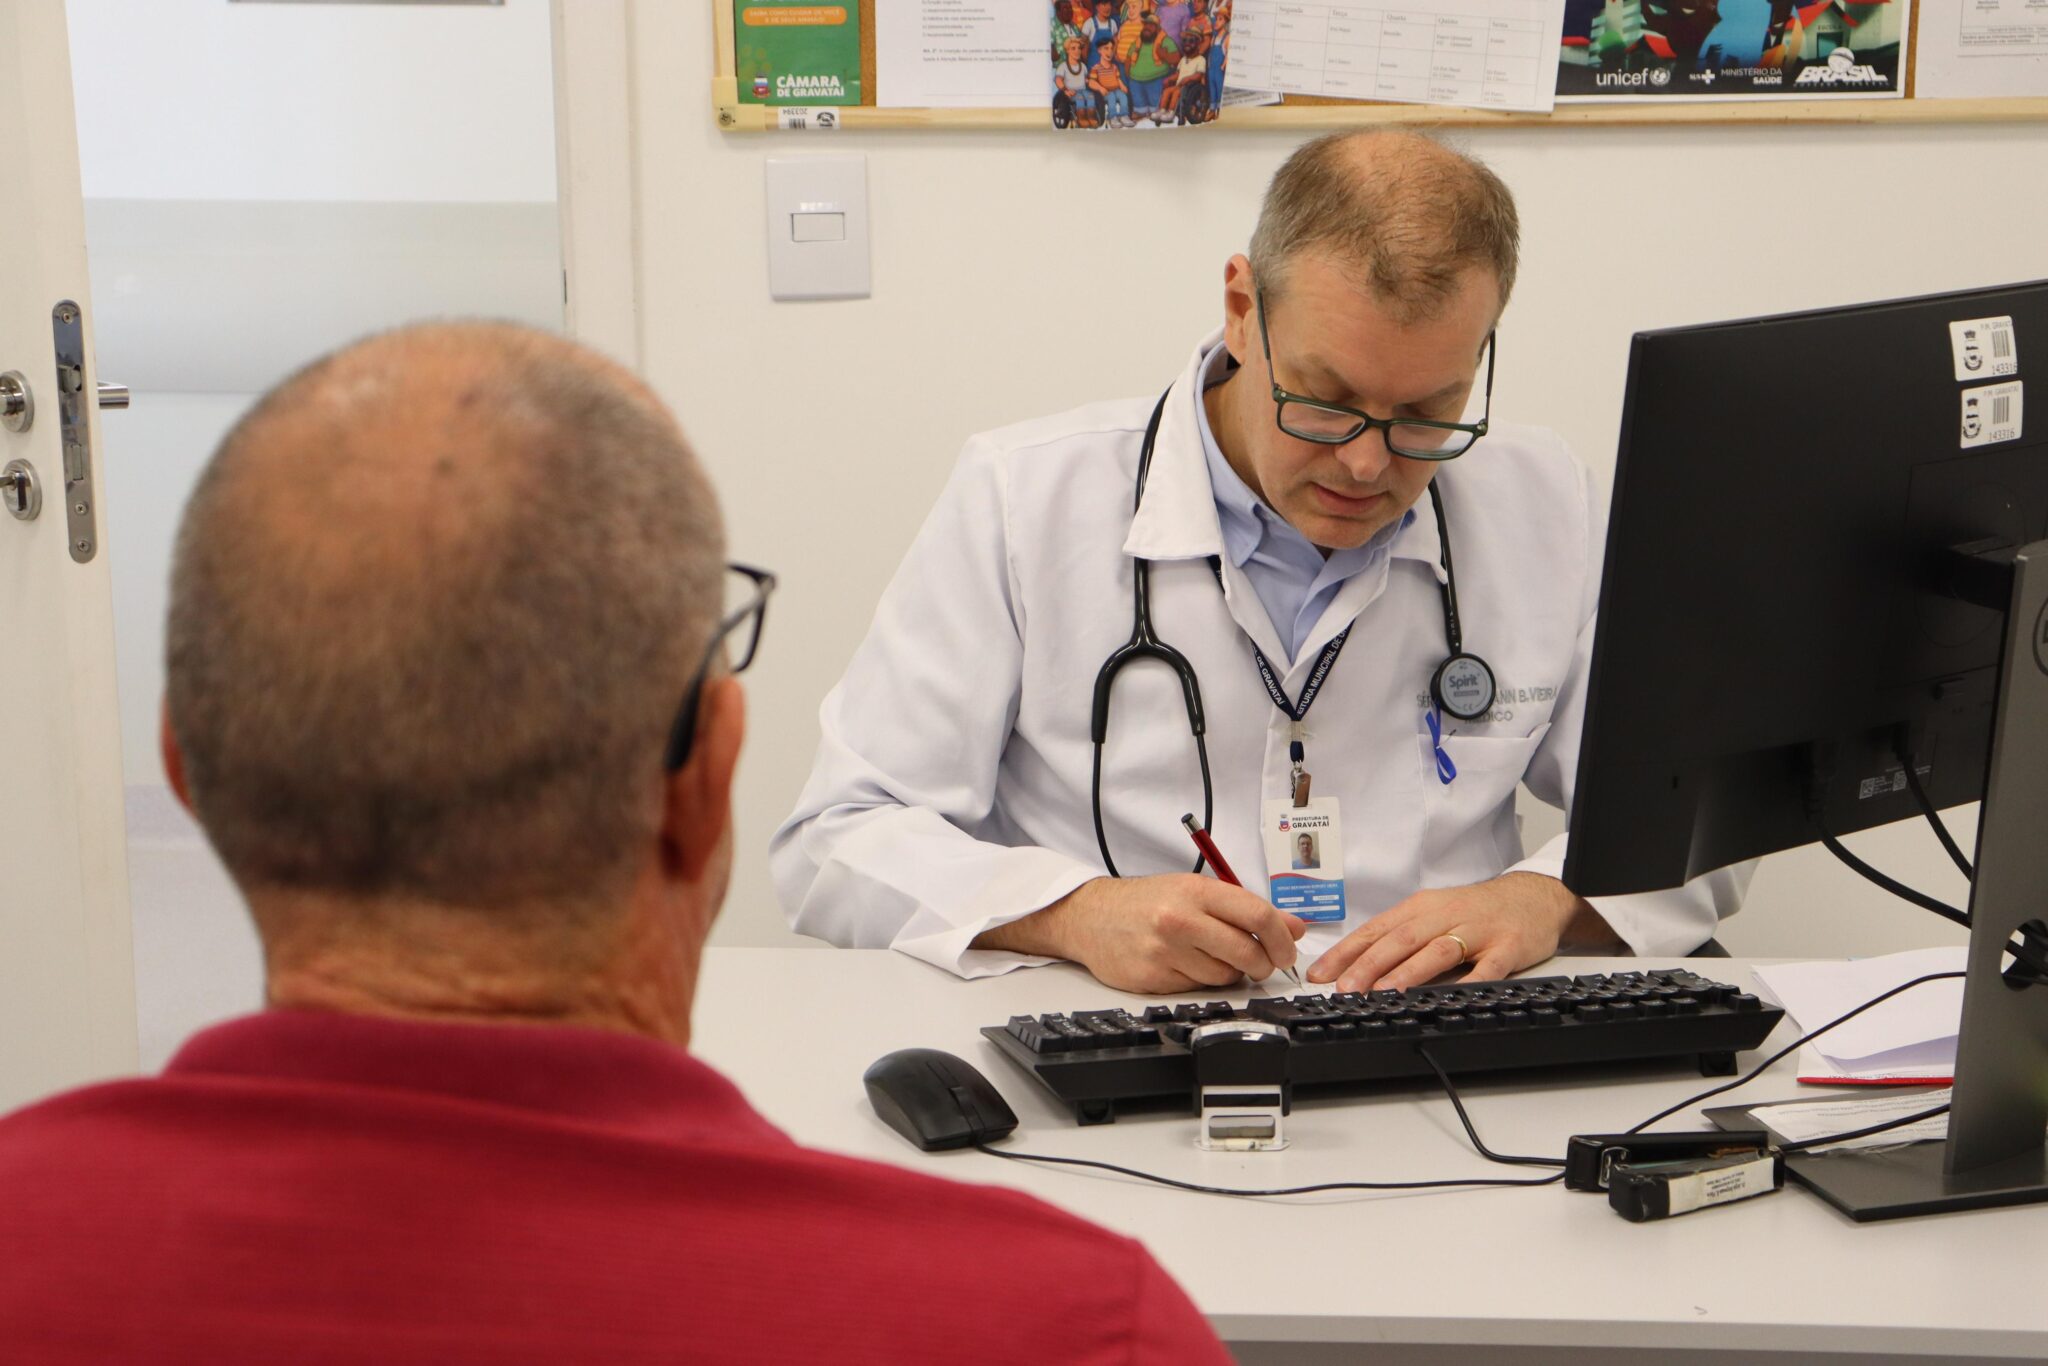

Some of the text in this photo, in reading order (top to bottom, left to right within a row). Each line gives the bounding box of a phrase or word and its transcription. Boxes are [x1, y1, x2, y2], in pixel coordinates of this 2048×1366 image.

[1596, 68, 1648, 86] unicef
[1721, 67, 1782, 76] MINISTÉRIO DA
[1796, 65, 1888, 83] BRASIL
[776, 73, 840, 88] CÂMARA
[1753, 76, 1782, 84] SAÚDE
[776, 86, 844, 98] DE GRAVATAÍ
[1256, 656, 1265, 666] DE
[1310, 650, 1336, 688] MUNICIPAL
[1332, 638, 1342, 650] DE
[1449, 674, 1478, 690] Spirit
[1292, 820, 1330, 829] GRAVATAÍ
